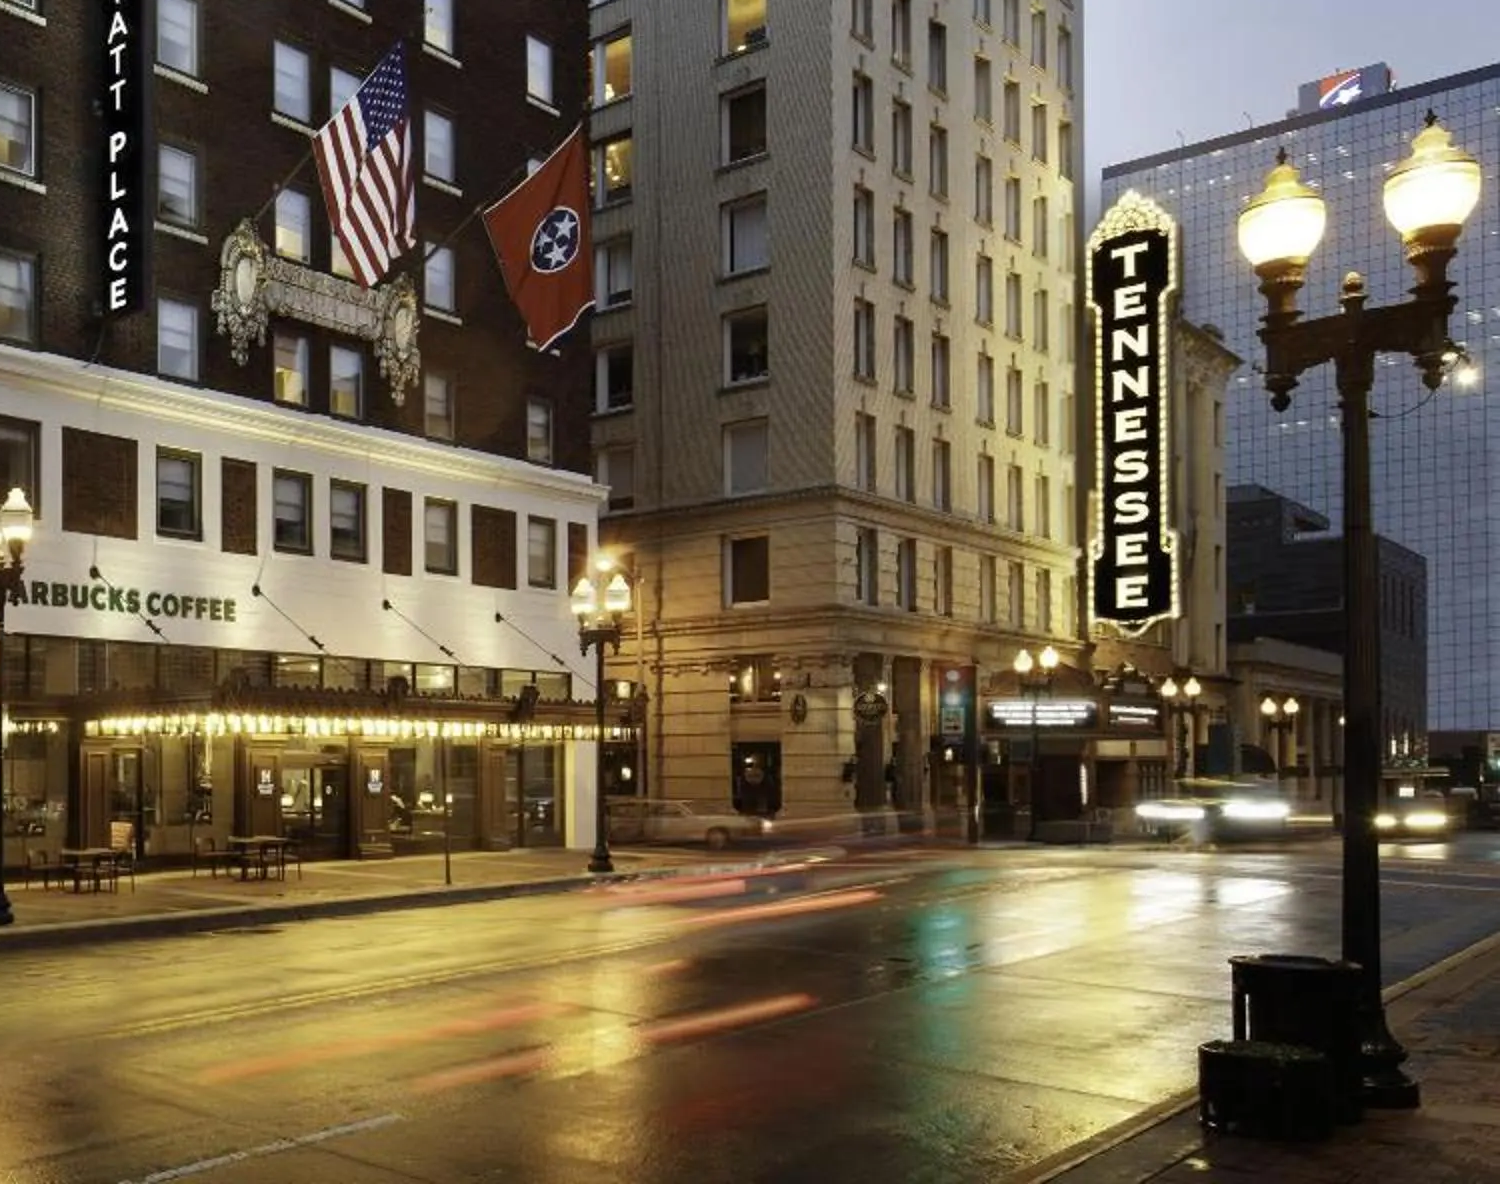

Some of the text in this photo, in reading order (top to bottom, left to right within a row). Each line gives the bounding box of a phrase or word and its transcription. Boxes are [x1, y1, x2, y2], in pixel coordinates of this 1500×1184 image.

[108, 132, 129, 310] PLACE
[1111, 243, 1150, 609] TENNESSEE
[146, 591, 237, 623] COFFEE
